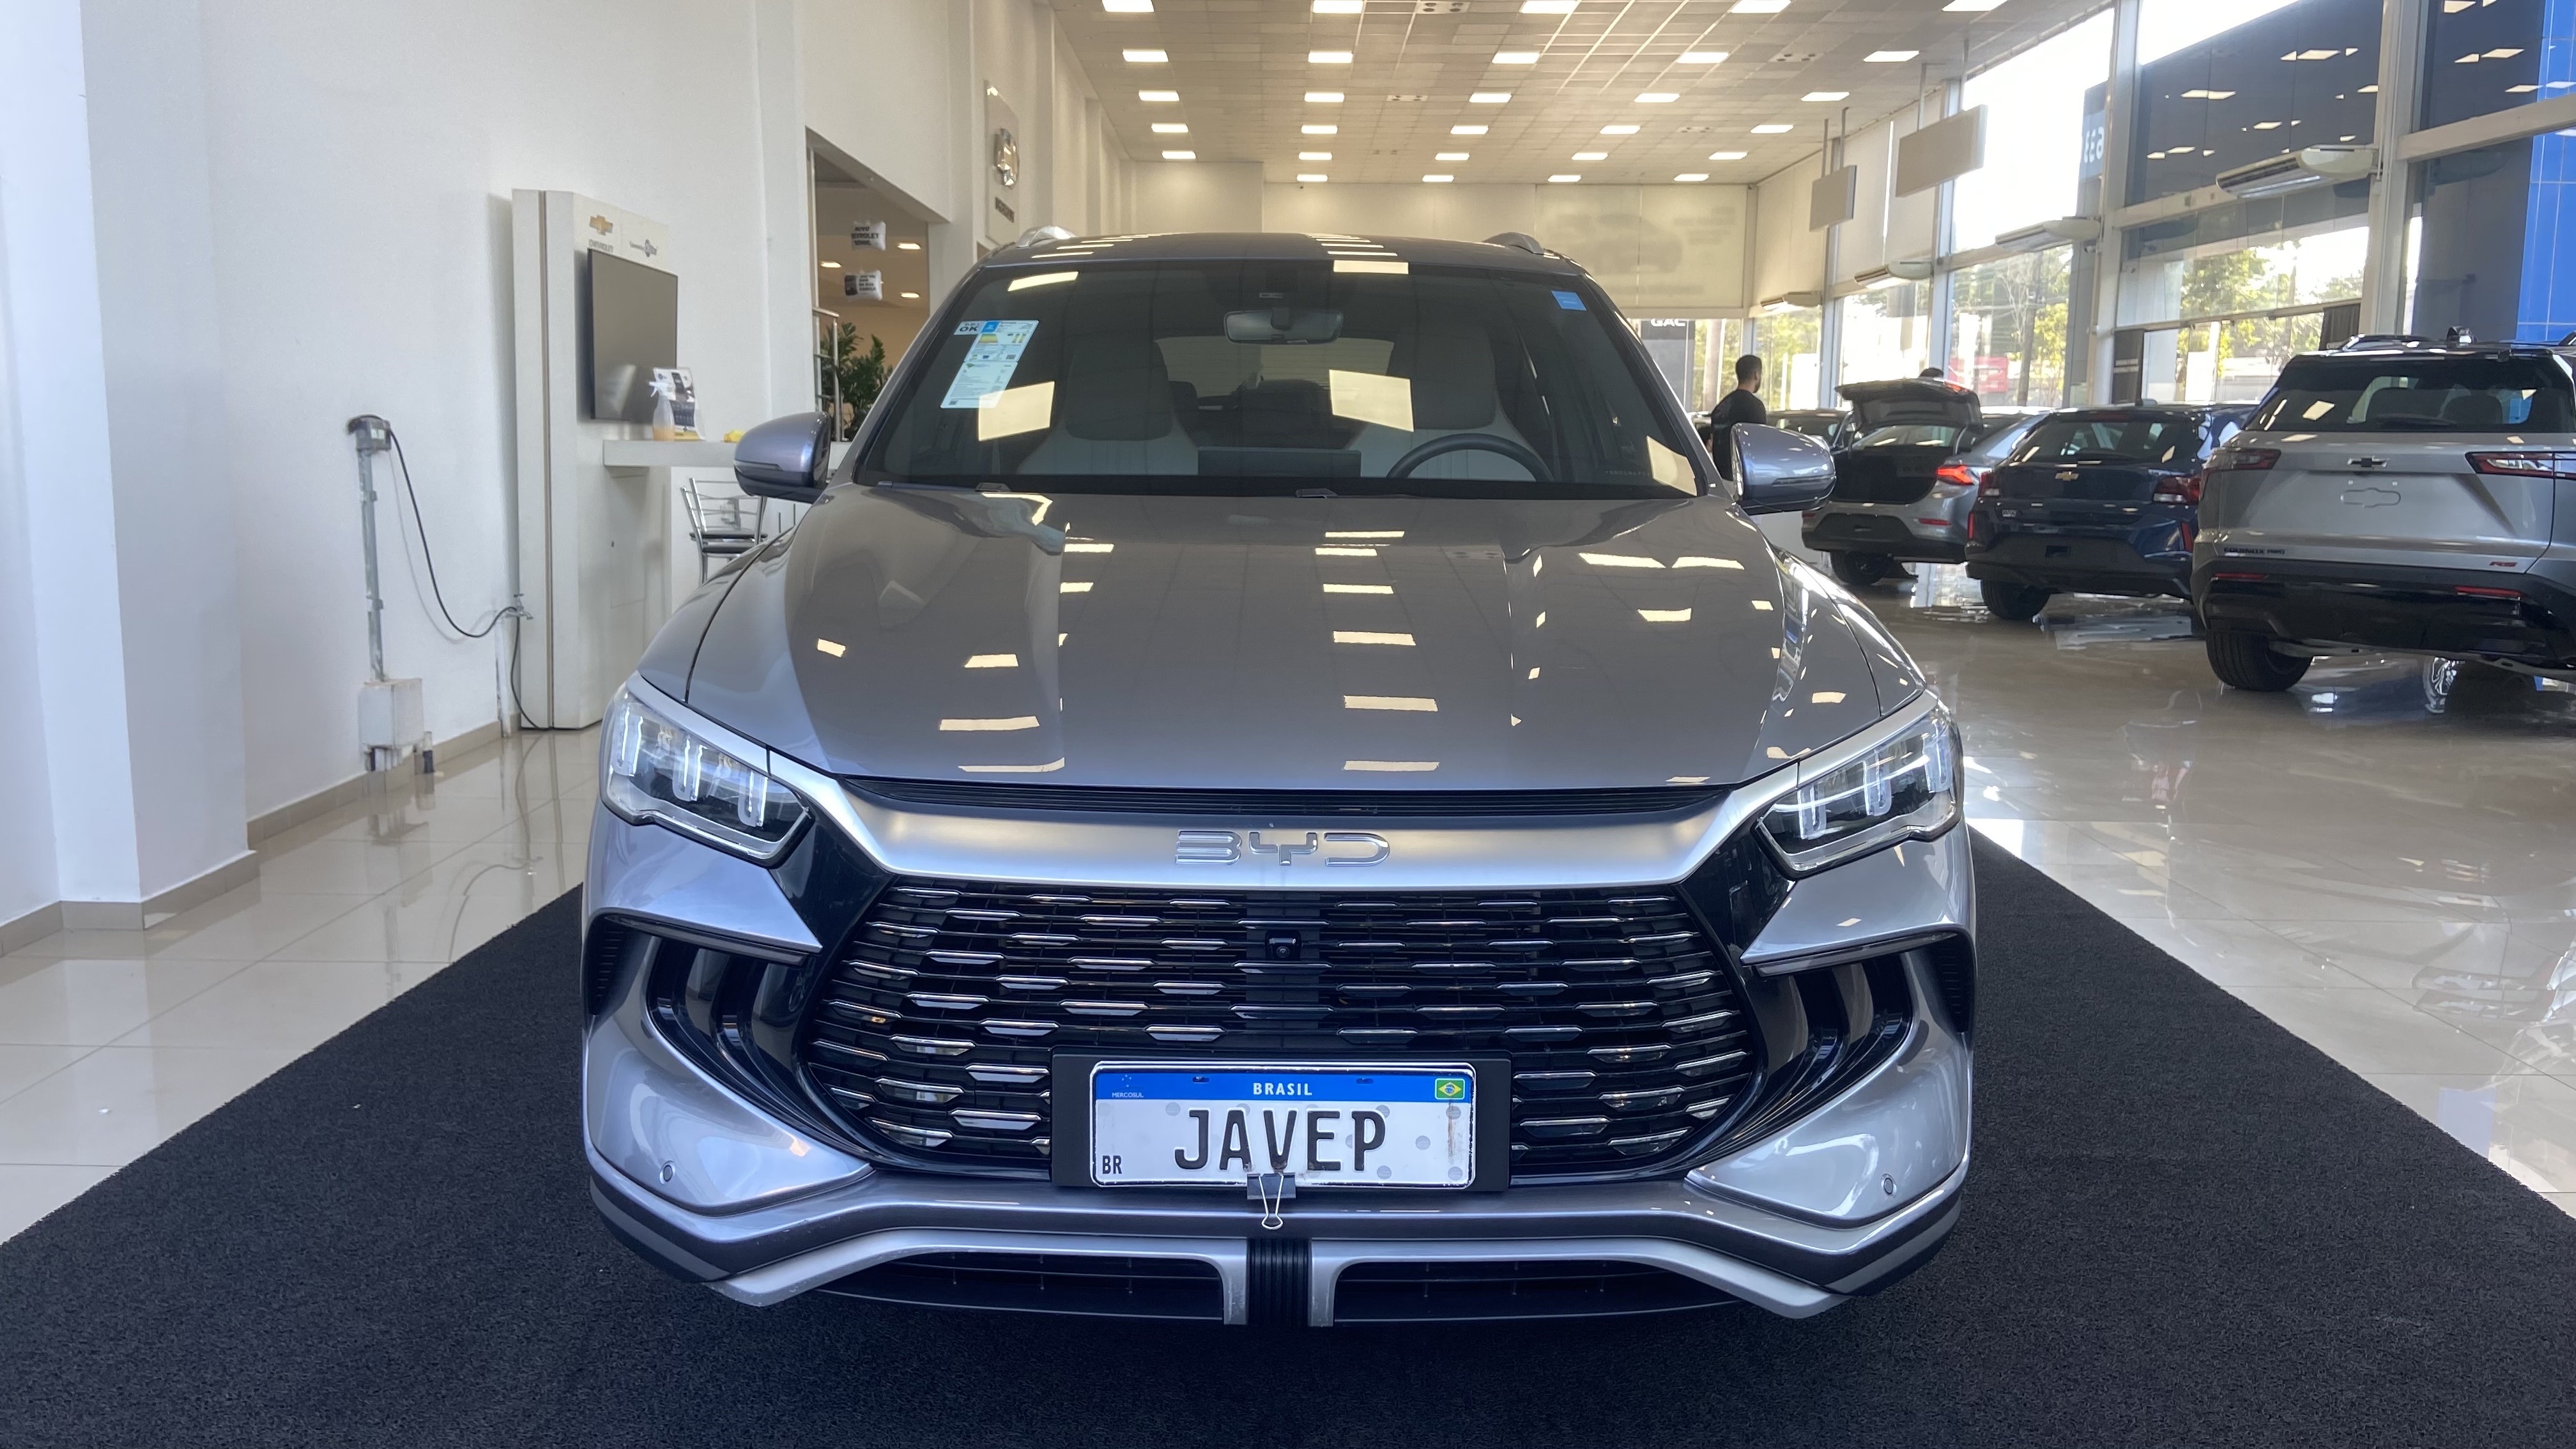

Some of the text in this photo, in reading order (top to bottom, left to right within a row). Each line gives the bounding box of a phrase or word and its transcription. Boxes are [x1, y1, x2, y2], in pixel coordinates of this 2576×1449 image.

[1176, 830, 1390, 866] BYD
[1253, 1082, 1313, 1096] BRASIL
[1174, 1108, 1386, 1172] JAVEP
[1101, 1155, 1123, 1175] BR
